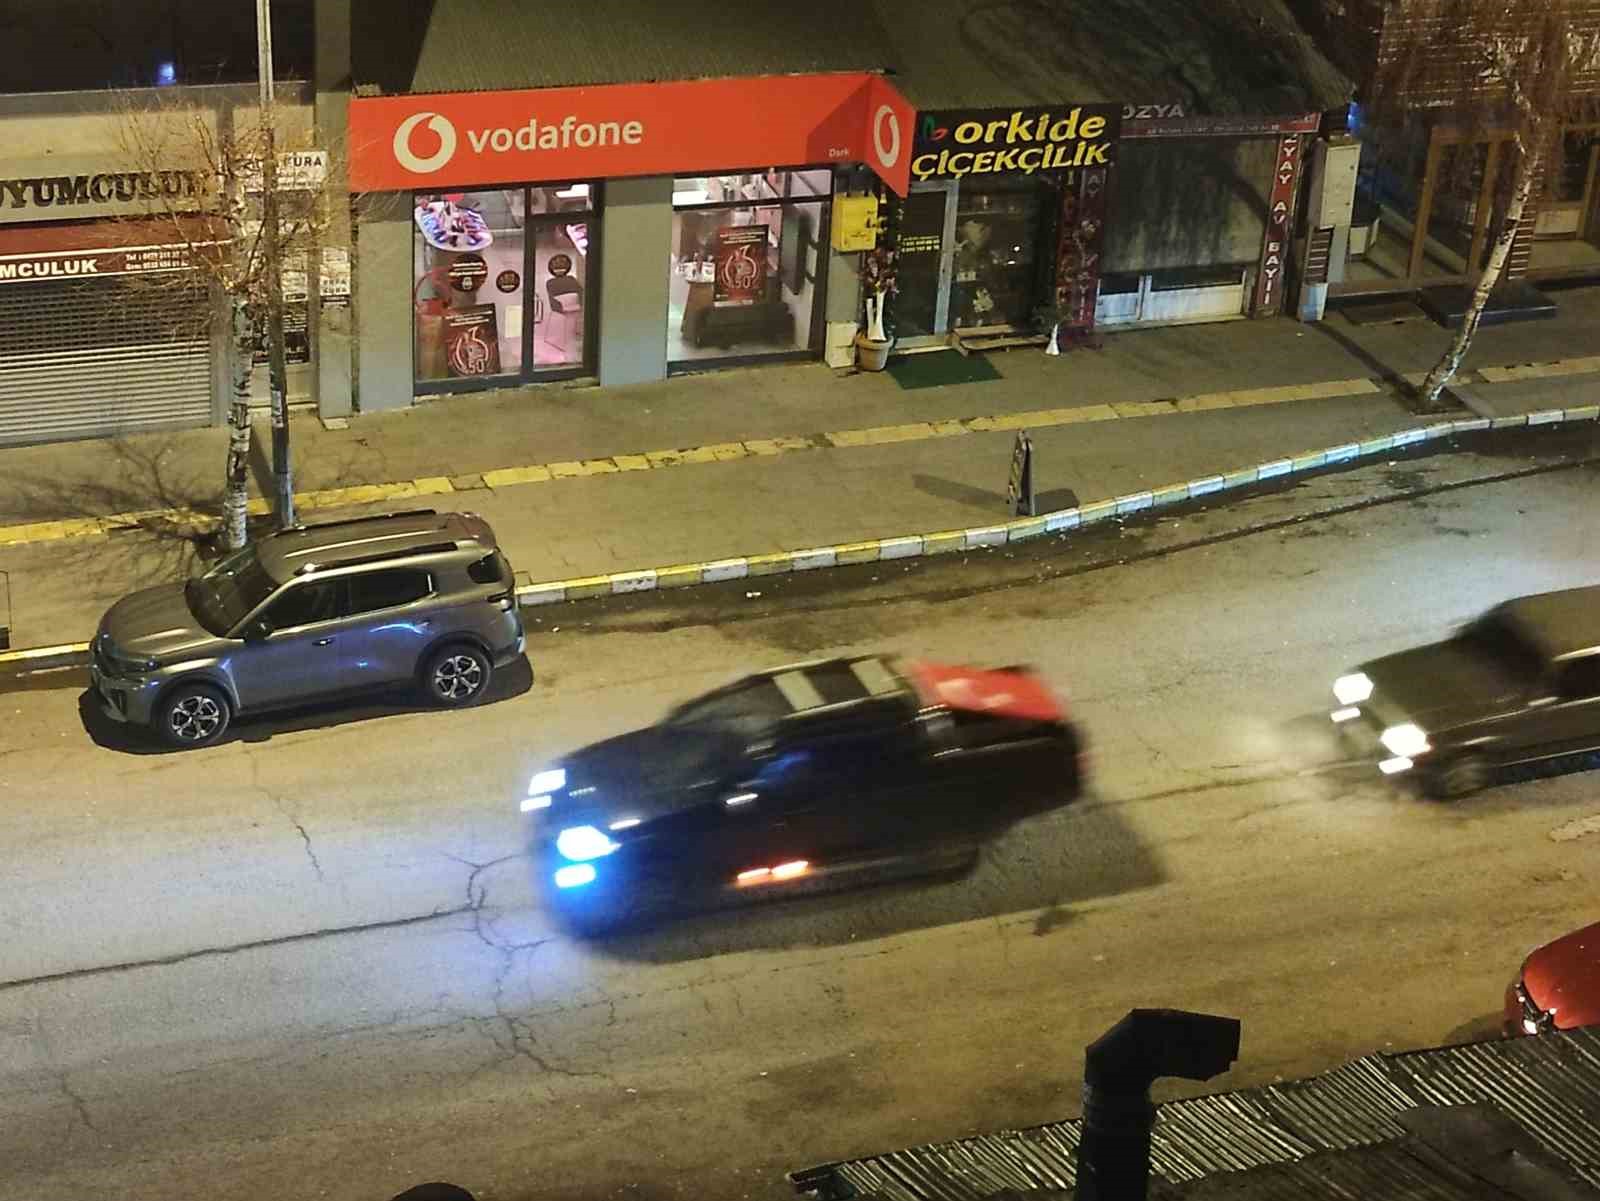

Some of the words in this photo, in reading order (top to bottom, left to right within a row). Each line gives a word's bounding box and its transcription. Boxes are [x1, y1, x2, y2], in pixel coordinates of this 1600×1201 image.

[467, 116, 643, 153] vodafone
[954, 107, 1106, 144] orkide
[0, 259, 97, 278] MCULUK
